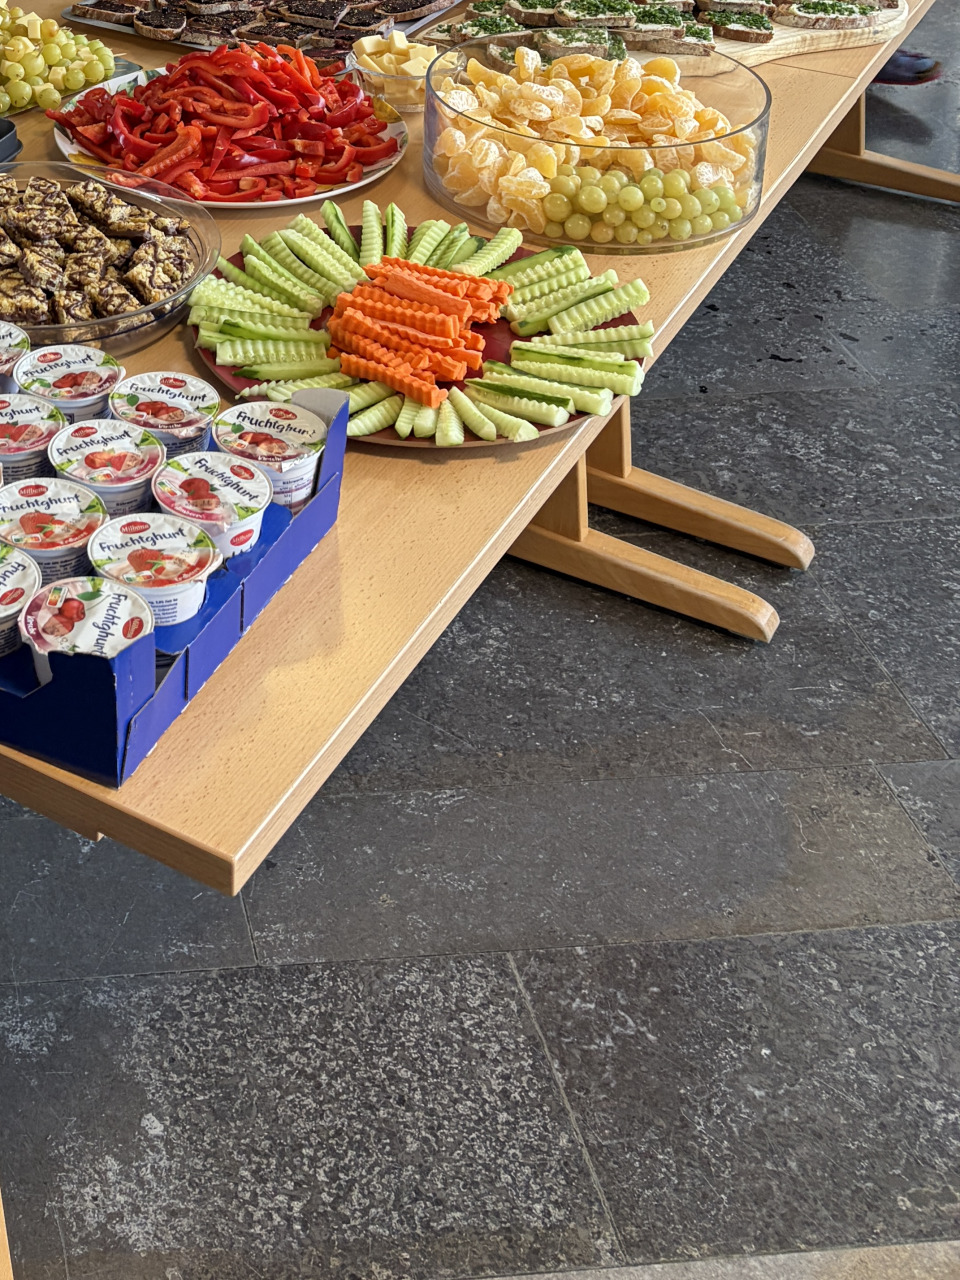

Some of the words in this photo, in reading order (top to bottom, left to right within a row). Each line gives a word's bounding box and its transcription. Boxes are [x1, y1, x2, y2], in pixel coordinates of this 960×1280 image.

[23, 353, 95, 378] Fruchtghurt
[129, 382, 208, 403] Fruchtghurt
[236, 410, 316, 438] Fruchtghurt
[56, 429, 133, 457] Fruchtghurt
[19, 486, 48, 496] Milbona
[194, 457, 260, 502] Fruchtghurt
[99, 527, 188, 554] Fruchtghurt
[121, 522, 151, 534] Milbona
[92, 592, 128, 657] Fruchtghurt
